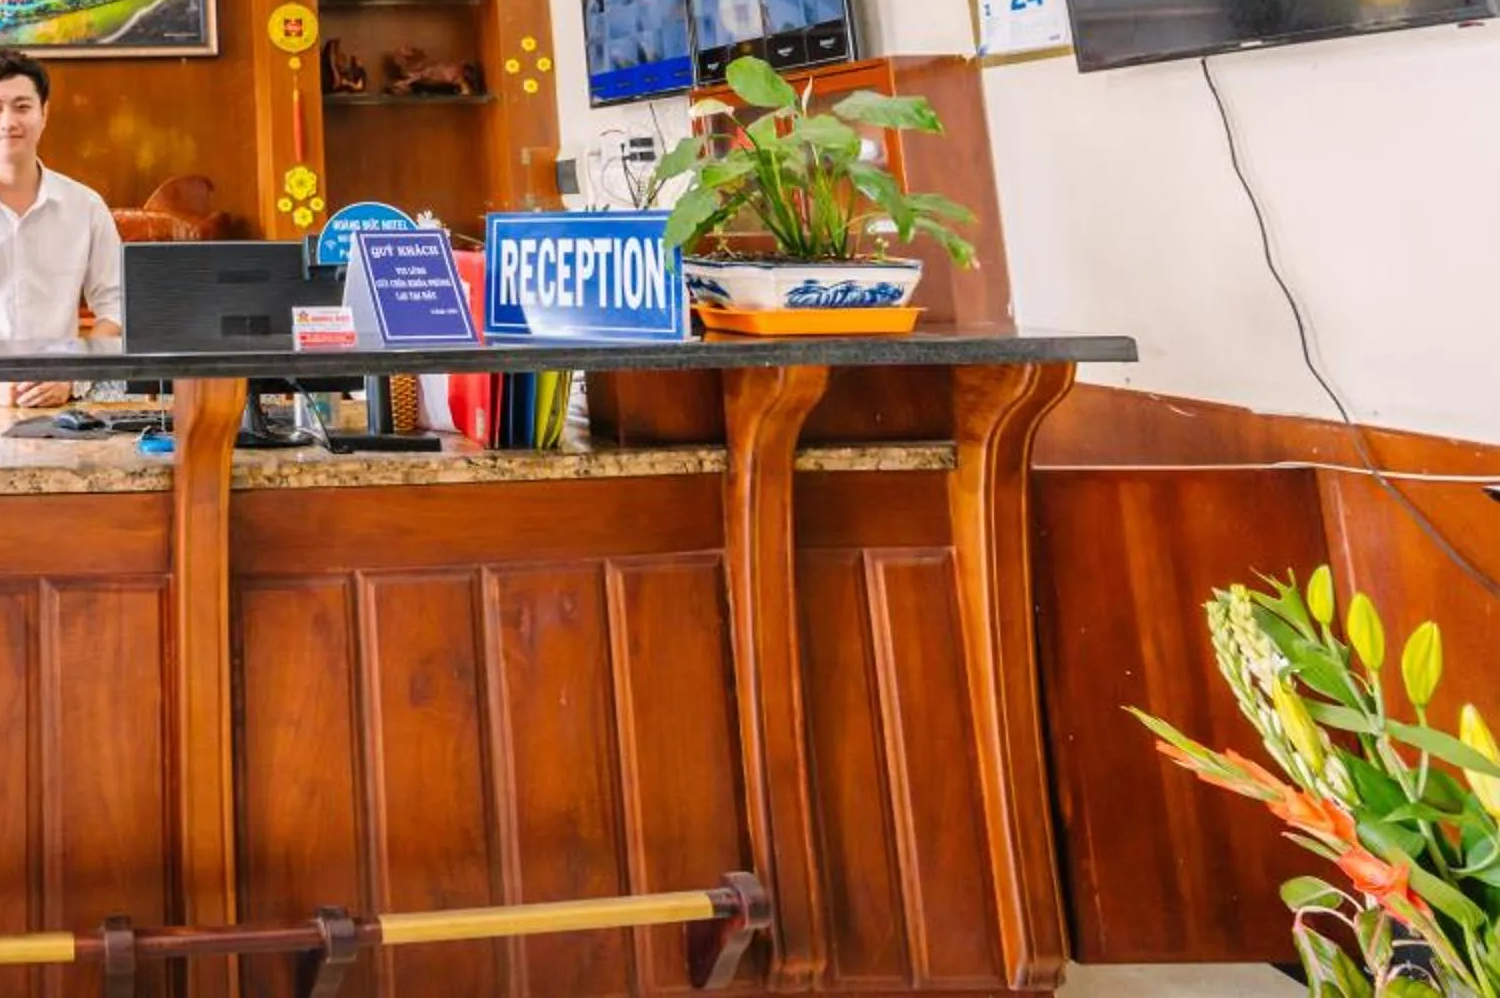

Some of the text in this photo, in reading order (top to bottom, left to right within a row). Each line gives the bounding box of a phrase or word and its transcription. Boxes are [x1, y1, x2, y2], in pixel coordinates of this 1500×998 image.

[382, 219, 408, 231] HOTEL
[397, 243, 440, 257] KHÁCH
[500, 236, 668, 310] RECEPTION
